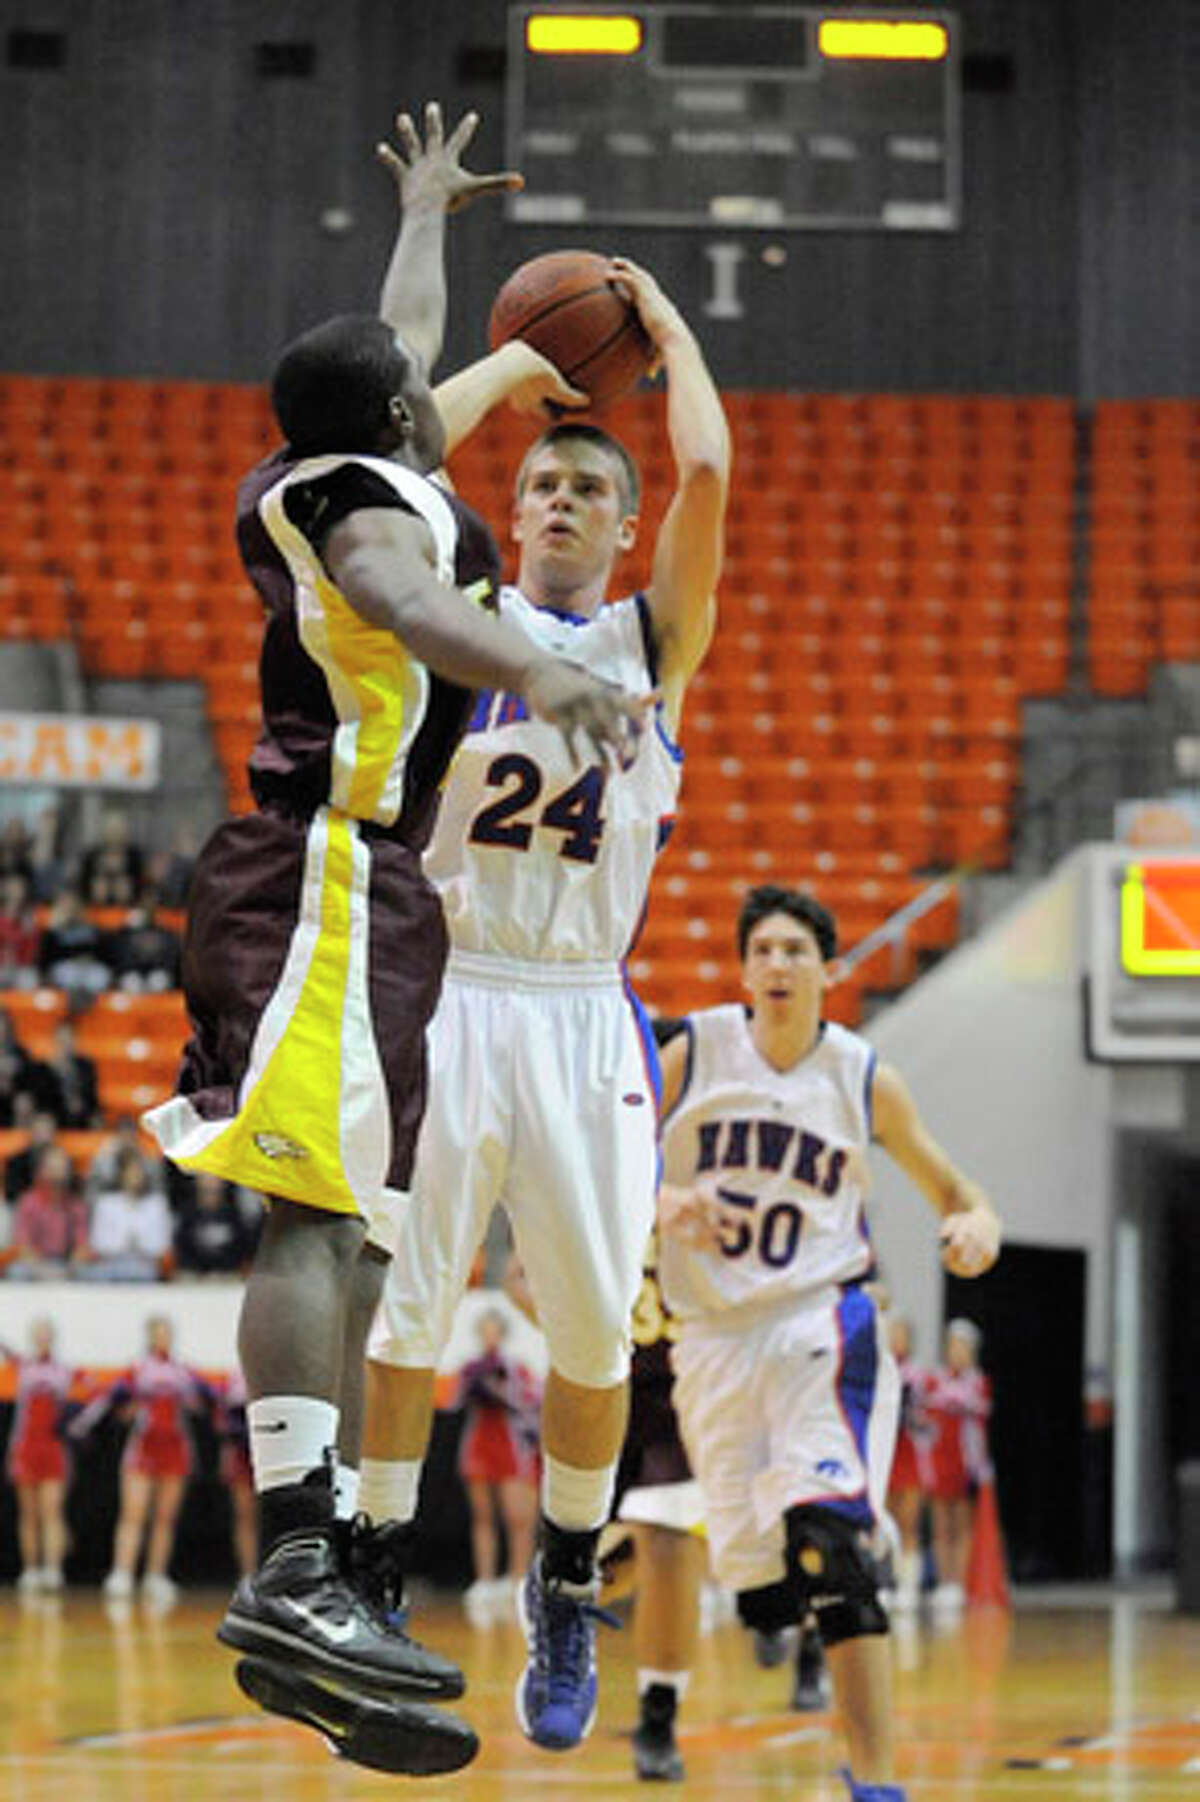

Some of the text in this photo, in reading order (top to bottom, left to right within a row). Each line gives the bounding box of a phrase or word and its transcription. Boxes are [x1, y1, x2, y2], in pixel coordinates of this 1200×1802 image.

[468, 754, 606, 864] 24
[695, 1120, 848, 1198] HAWKS
[714, 1186, 804, 1269] 50
